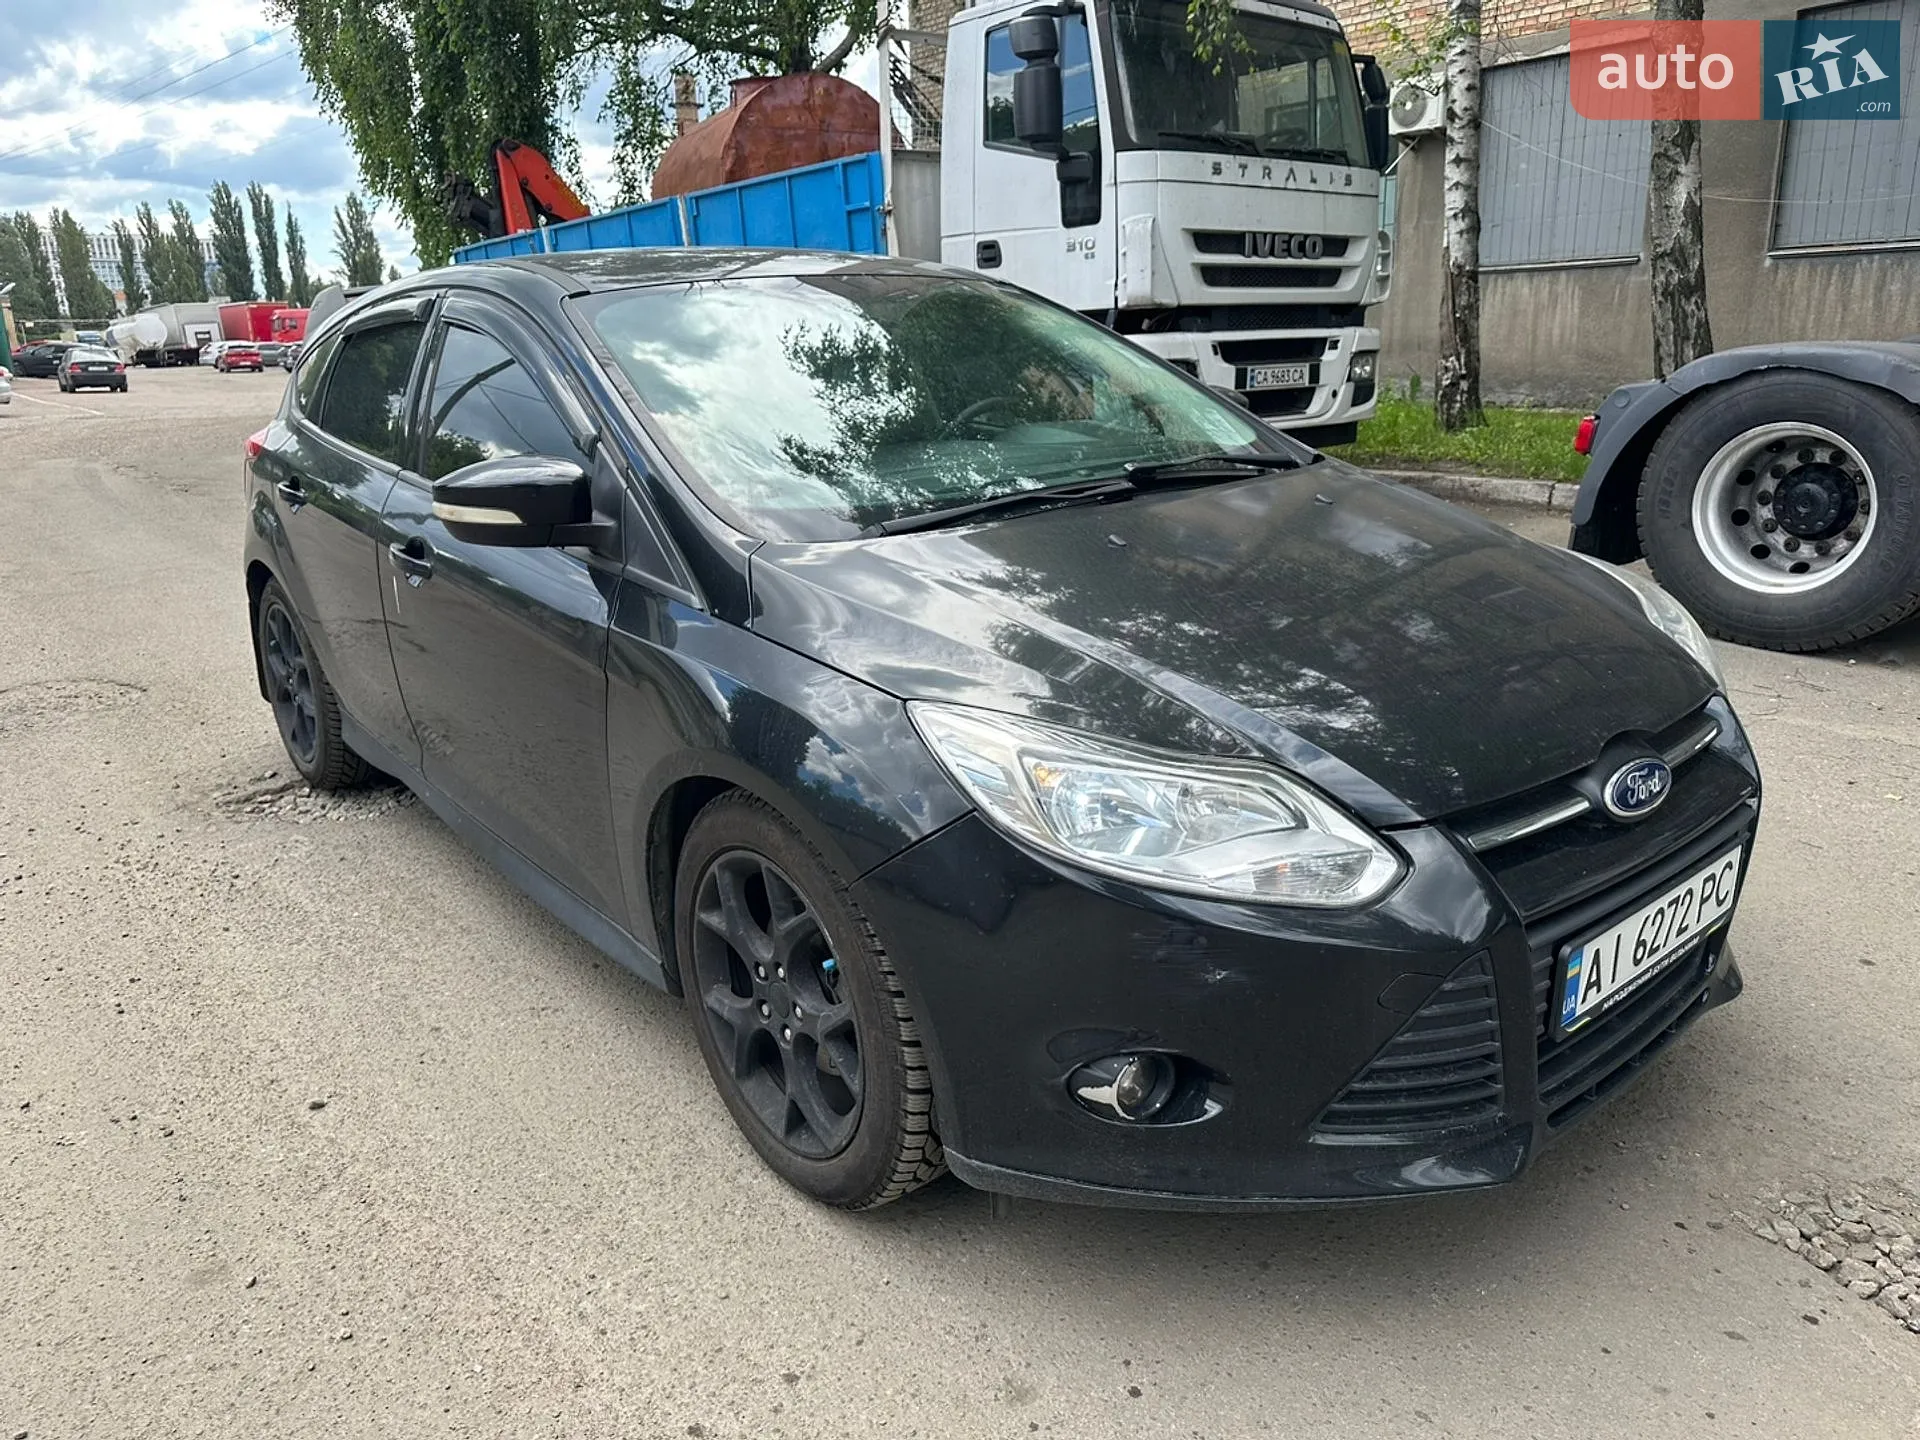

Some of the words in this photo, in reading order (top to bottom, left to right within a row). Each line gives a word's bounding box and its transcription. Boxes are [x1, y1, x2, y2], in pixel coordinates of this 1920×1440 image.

[1211, 160, 1353, 187] STRALIS
[1243, 230, 1324, 260] IVECO
[1256, 370, 1268, 385] CA
[1270, 368, 1291, 384] 9683
[1292, 367, 1305, 383] CA
[1627, 767, 1660, 805] Ford
[1580, 932, 1622, 1005] AI
[1632, 886, 1694, 967] 6272
[1696, 859, 1734, 925] PC
[1562, 993, 1576, 1016] UA
